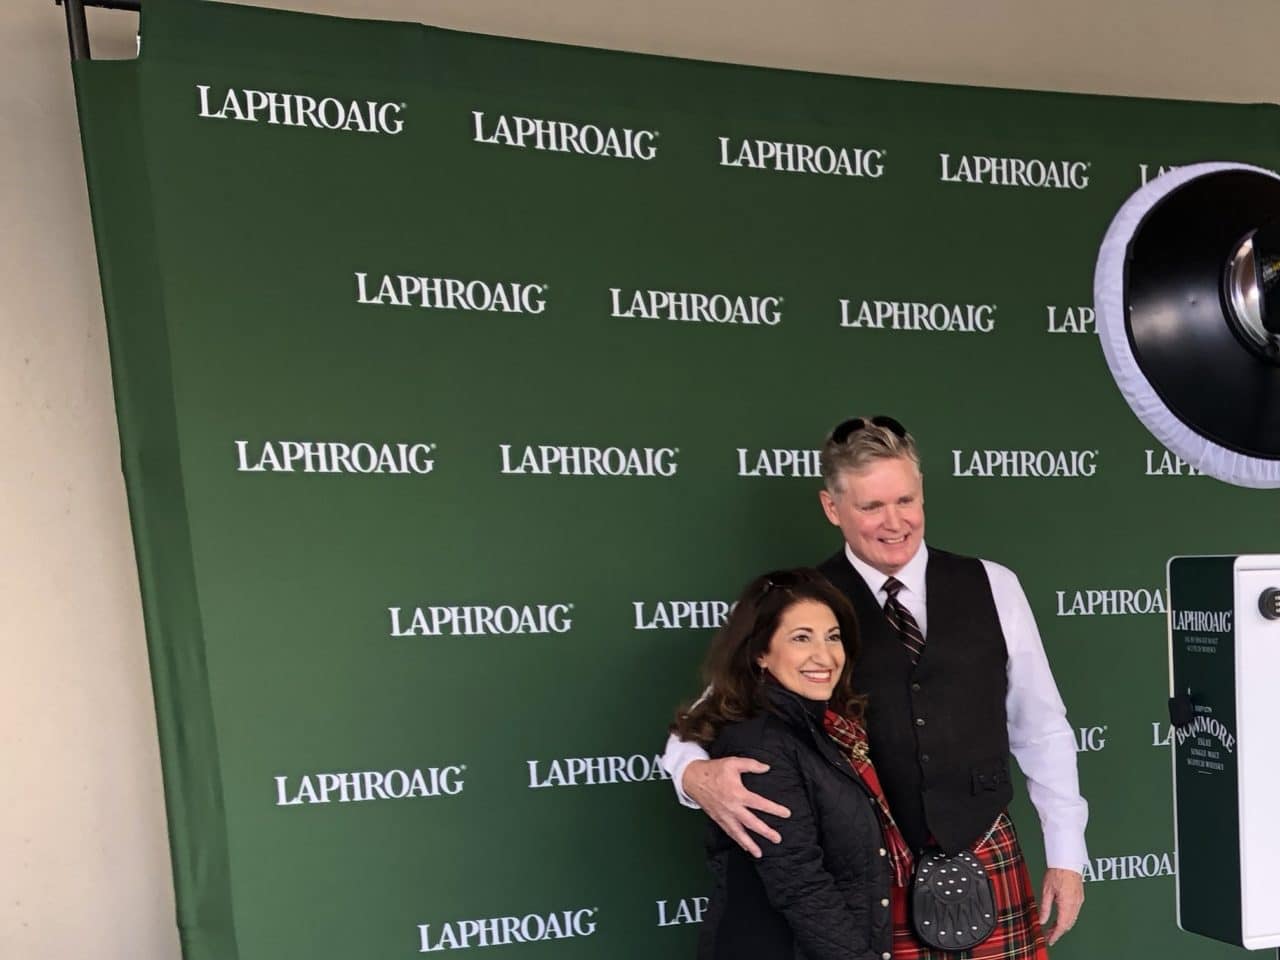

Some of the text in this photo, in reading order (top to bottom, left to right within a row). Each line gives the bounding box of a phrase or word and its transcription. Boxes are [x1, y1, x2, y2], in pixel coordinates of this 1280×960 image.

[197, 84, 406, 135] LAPHROAIG
[472, 110, 659, 161] LAPHROAIG
[719, 136, 886, 178] LAPHROAIG
[940, 153, 1091, 190] LAPHROAIG
[355, 272, 548, 314] LAPHROAIG
[610, 287, 783, 326] LAPHROAIG
[840, 299, 997, 333] LAPHROAIG
[235, 440, 437, 475] LAPHROAIG
[500, 444, 680, 477] LAPHROAIG
[952, 449, 1099, 477] LAPHROAIG
[388, 603, 574, 637] LAPHROAIG
[632, 600, 739, 629] LAPHR
[1056, 588, 1168, 616] LAPHROA
[1172, 609, 1233, 633] LAPHROAIG
[1176, 715, 1235, 754] BOWMORE
[274, 764, 467, 806] LAPHROAIG
[526, 754, 672, 789] LAPHROA
[417, 907, 598, 953] LAPHROAIG
